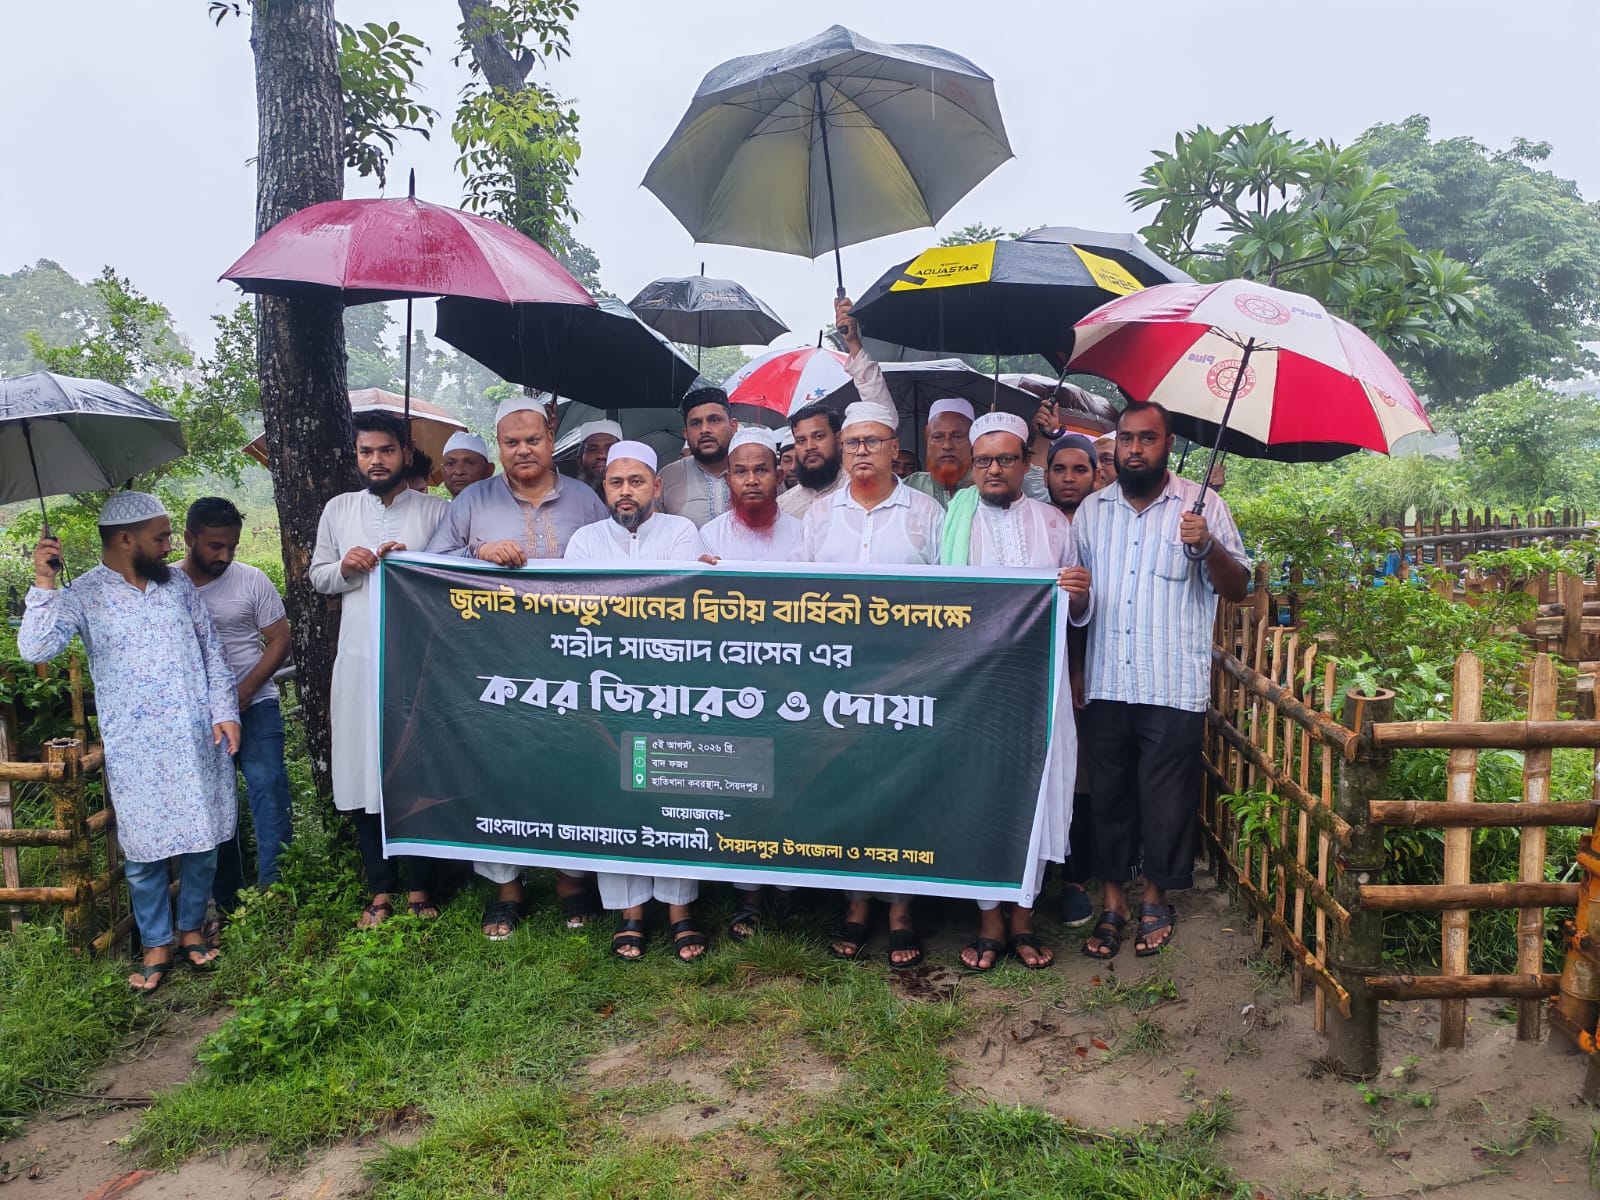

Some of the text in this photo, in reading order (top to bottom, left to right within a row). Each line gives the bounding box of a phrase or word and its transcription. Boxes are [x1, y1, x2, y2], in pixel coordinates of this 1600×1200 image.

[915, 263, 979, 276] AQUASTAR
[449, 585, 971, 629] জুলাই গণঅভ্যুত্থানের দ্বিতীয় বার্ষিকী উপলক্ষে
[551, 628, 852, 668] শহীদ সাজ্জাদ হোসেন এর
[476, 670, 937, 731] কবর জিয়ারত ও দোয়া
[652, 739, 664, 750] ৫ই
[697, 743, 721, 753] ২০২৬
[652, 759, 688, 769] বাদ ফজর
[476, 816, 934, 865] বাংলাদেশ জামায়াতে ইসলামী, সৈয়দপুর উপজেলা ও শহর শাখা
